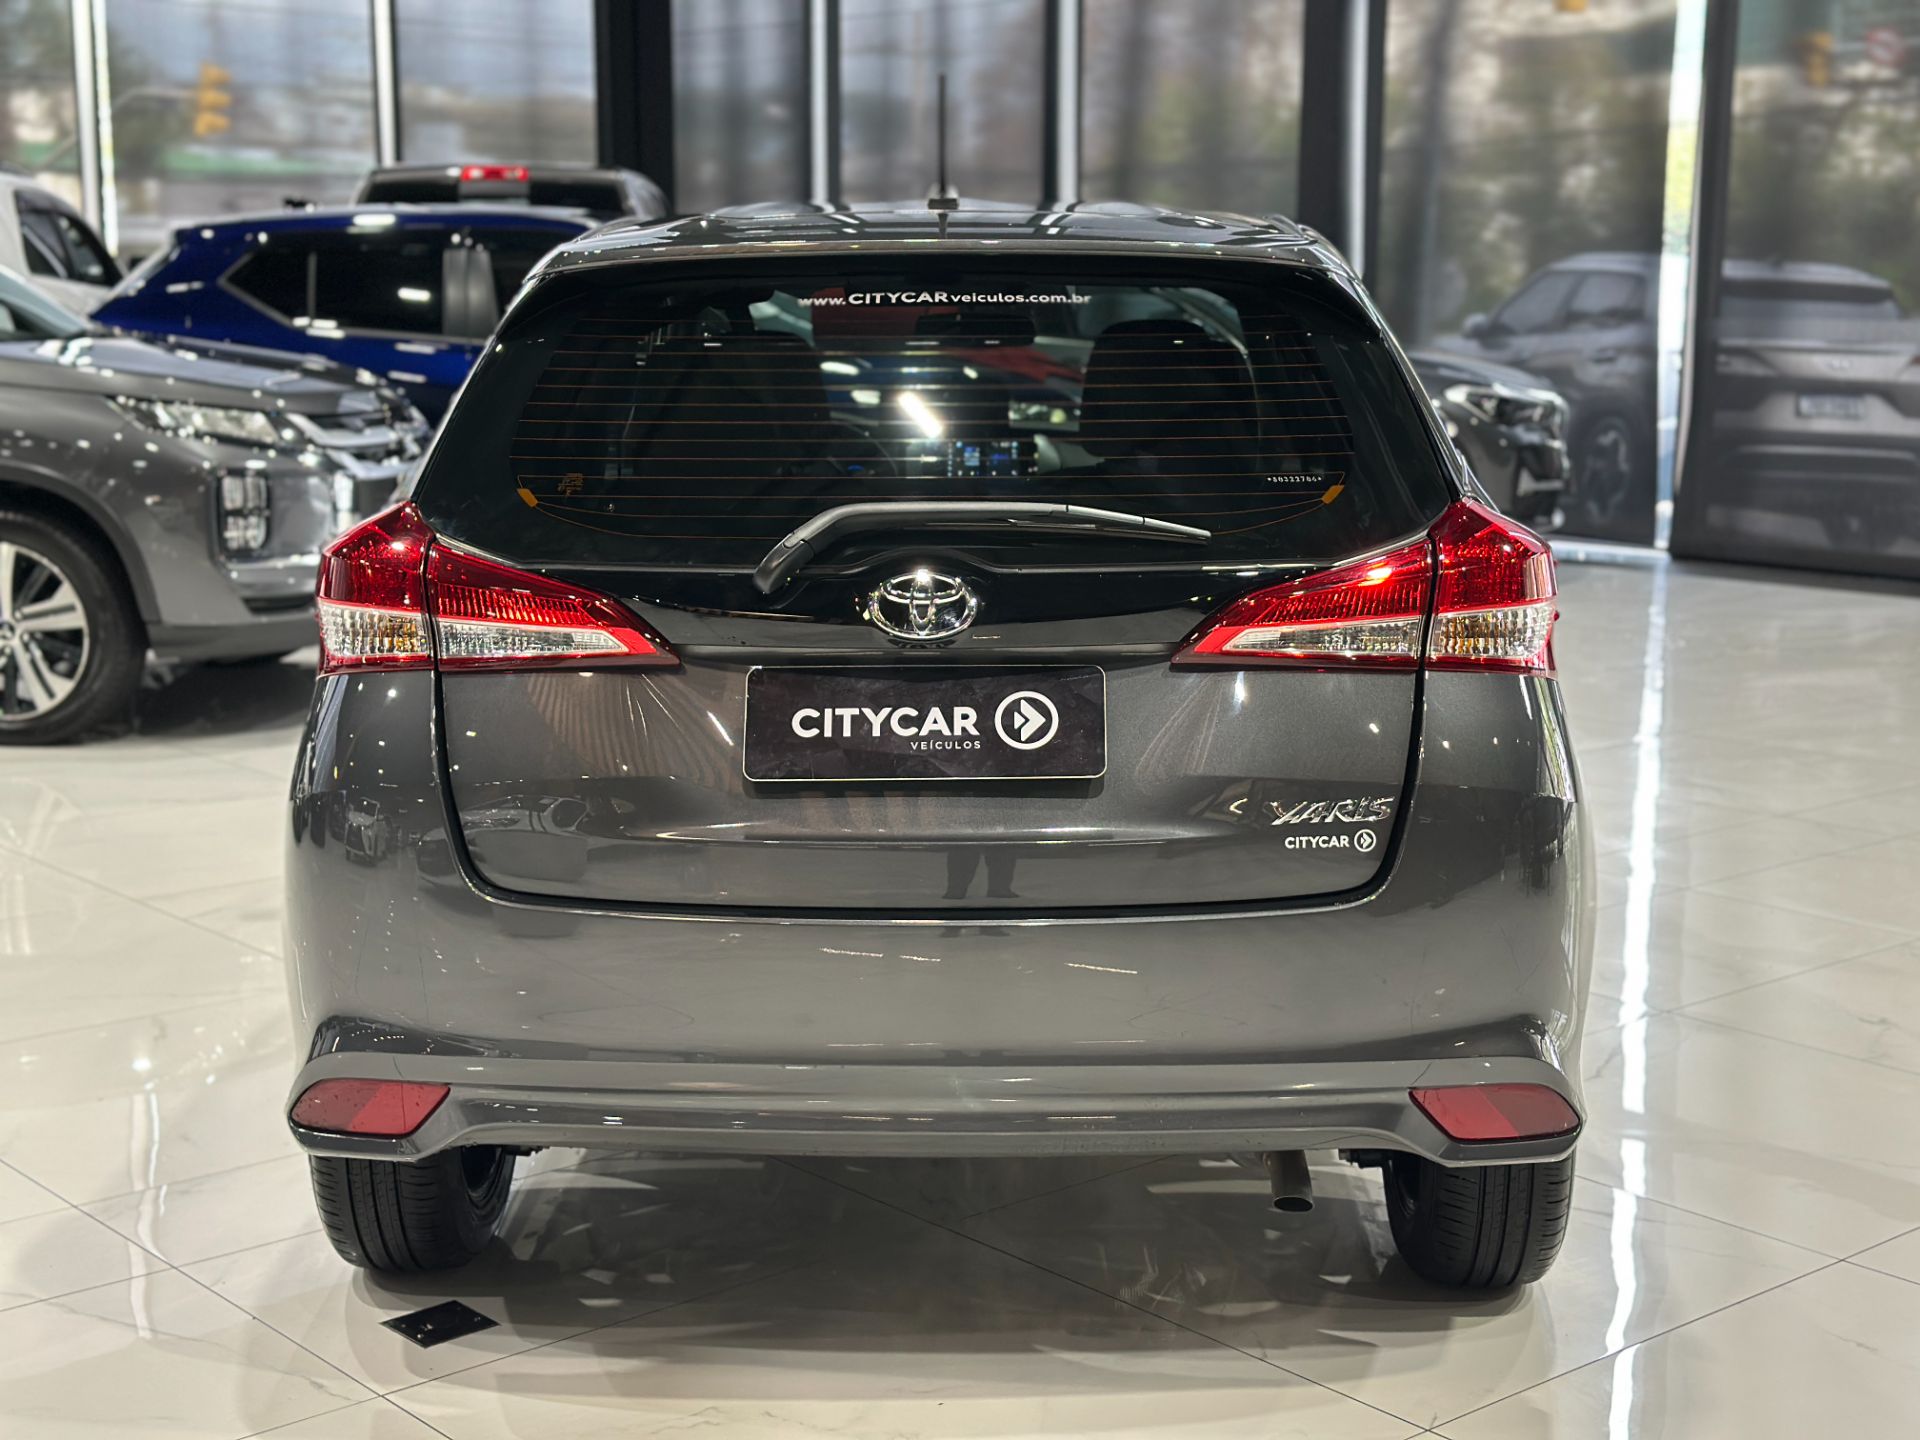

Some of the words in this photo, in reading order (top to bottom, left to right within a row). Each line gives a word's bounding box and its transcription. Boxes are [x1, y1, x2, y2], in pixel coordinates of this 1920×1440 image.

[791, 706, 981, 738] CITYCAR
[910, 739, 981, 750] VEÍCULOS
[1269, 797, 1395, 826] YARIS
[1284, 835, 1350, 849] CITYCAR
